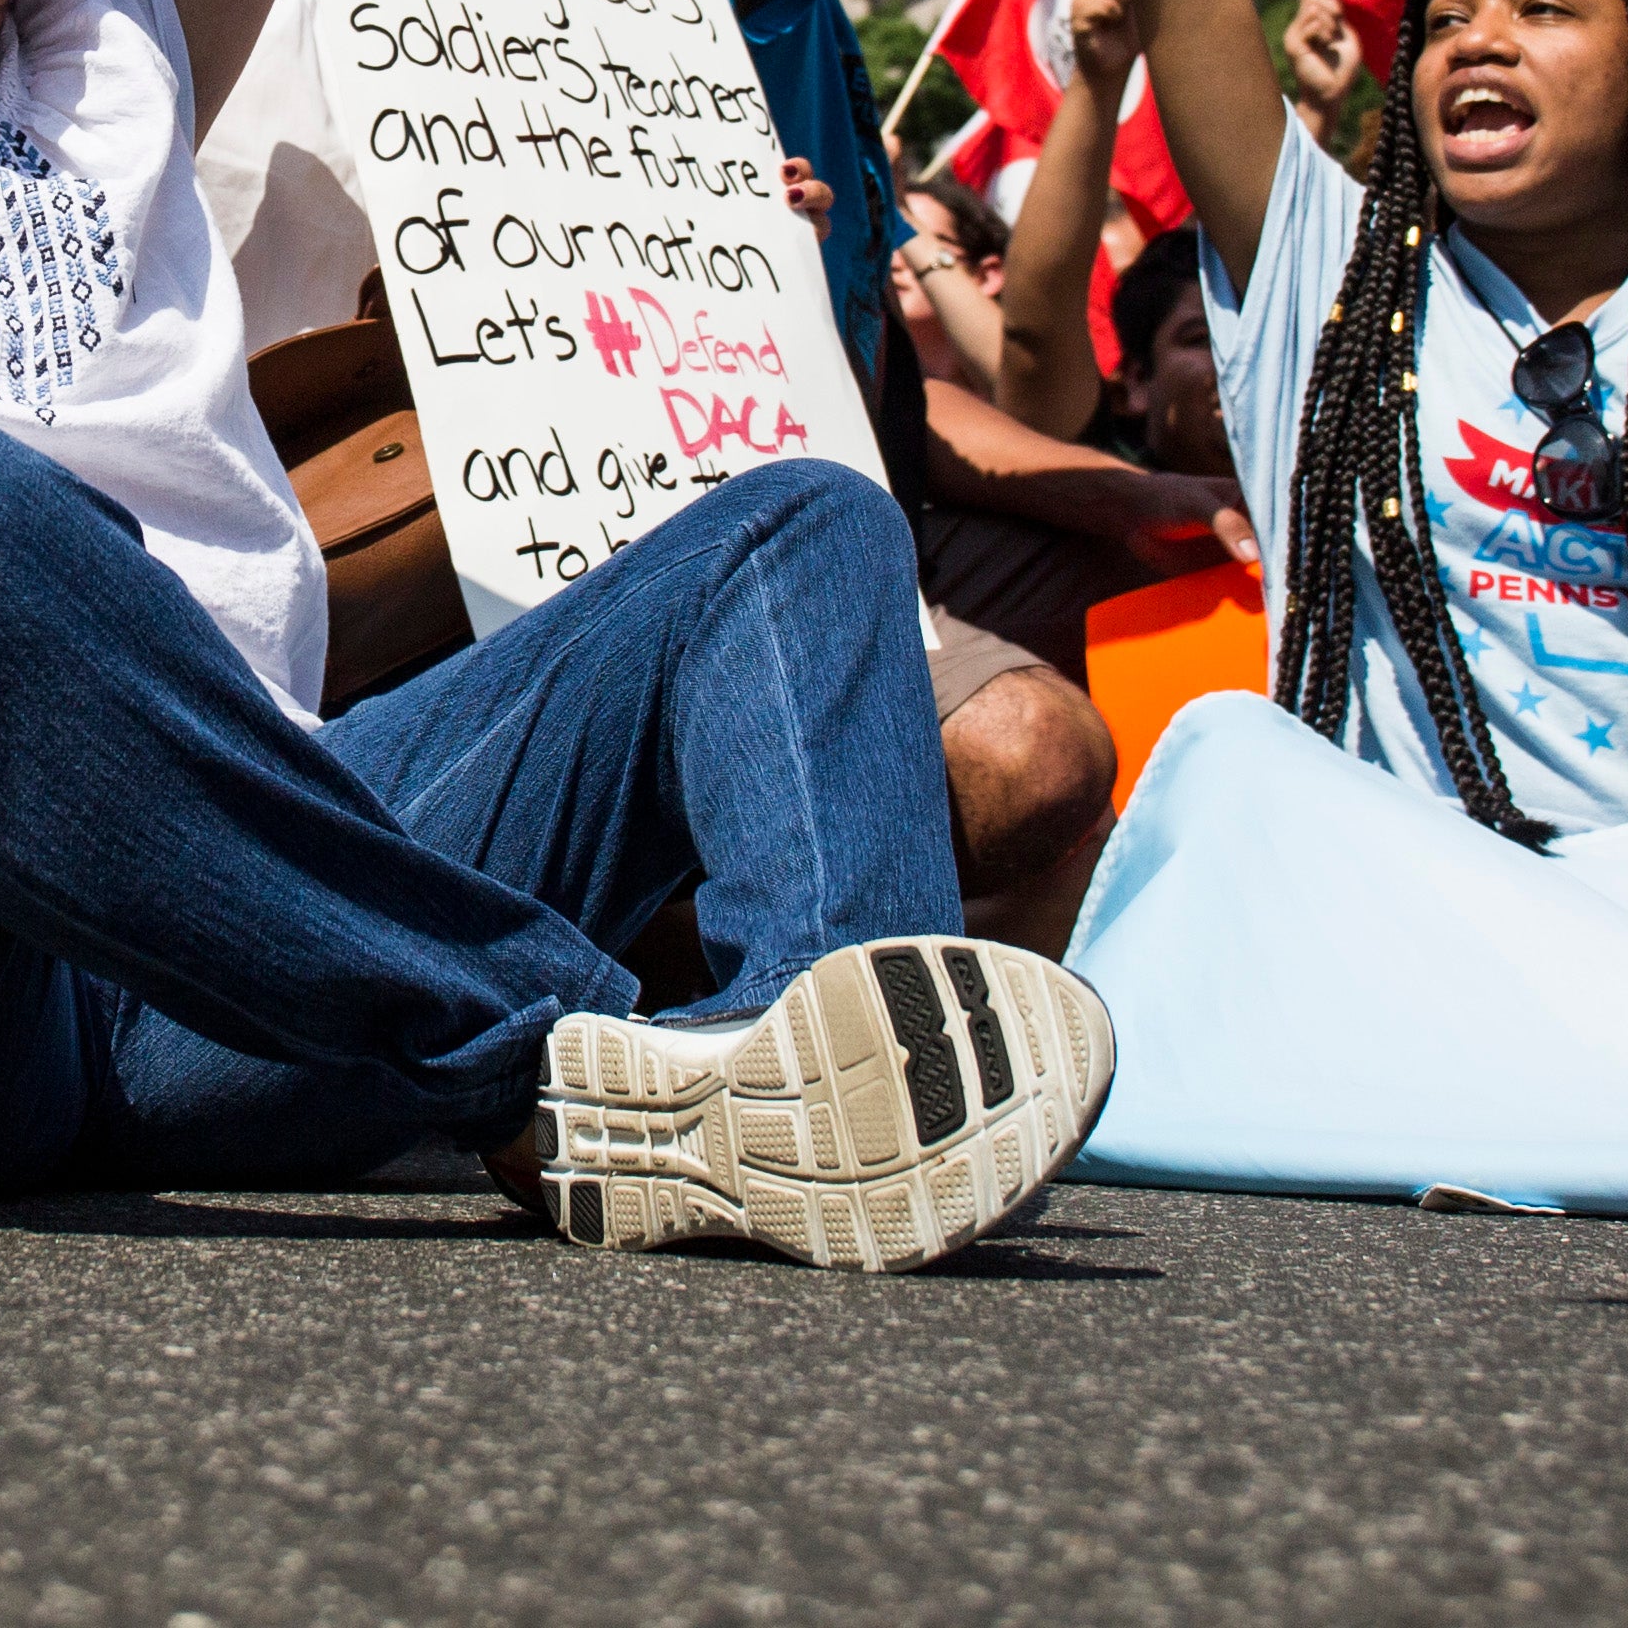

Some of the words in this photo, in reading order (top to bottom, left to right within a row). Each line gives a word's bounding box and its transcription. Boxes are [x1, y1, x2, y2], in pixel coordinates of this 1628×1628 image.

[370, 97, 506, 168] and
[516, 99, 622, 179] the
[627, 124, 770, 199] future
[394, 187, 470, 275] of
[492, 213, 594, 269] our
[604, 215, 781, 293] nation
[411, 288, 579, 367] Let's
[658, 385, 808, 460] DACA
[462, 425, 580, 502] and
[597, 442, 678, 519] give
[516, 516, 589, 582] to
